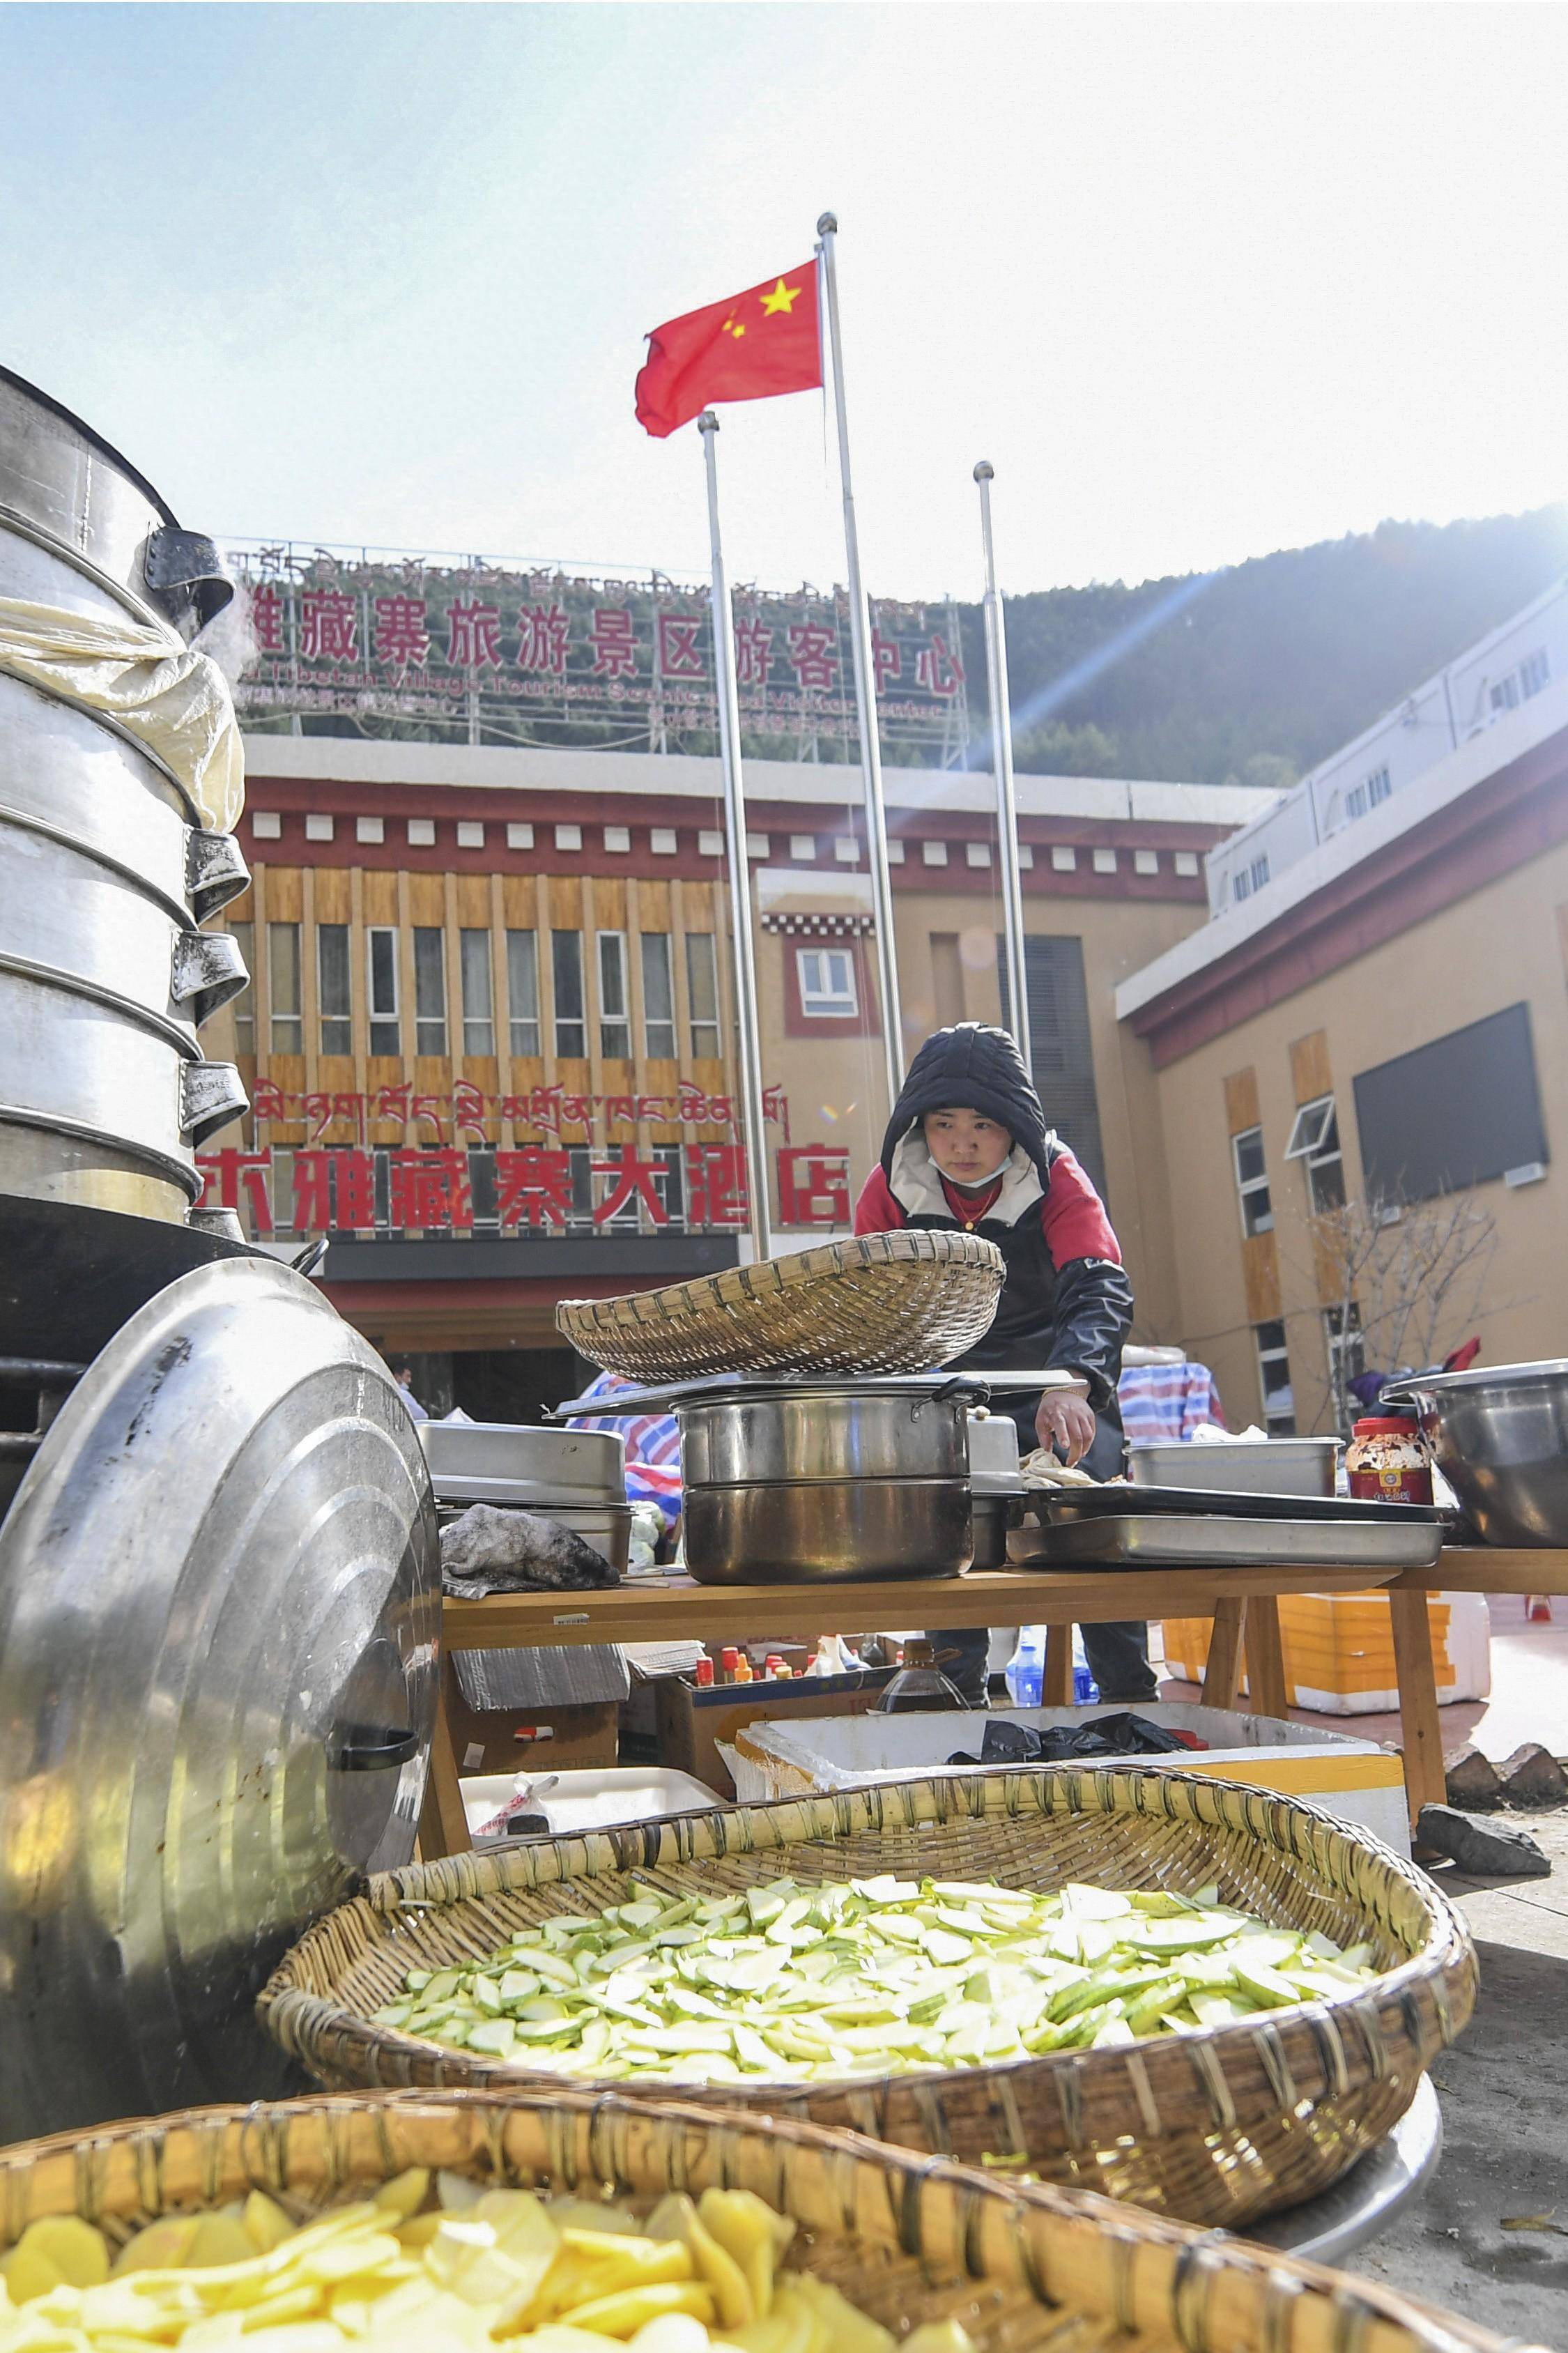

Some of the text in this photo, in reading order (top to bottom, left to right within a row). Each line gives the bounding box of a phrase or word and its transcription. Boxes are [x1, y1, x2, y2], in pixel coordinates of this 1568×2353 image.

[268, 661, 377, 687] Tibetan
[384, 669, 484, 696] Village
[489, 674, 602, 700] Tourism
[608, 681, 700, 705] Scenic
[877, 700, 943, 719] enter
[193, 1143, 851, 1232] 木雅藏寨大酒店
